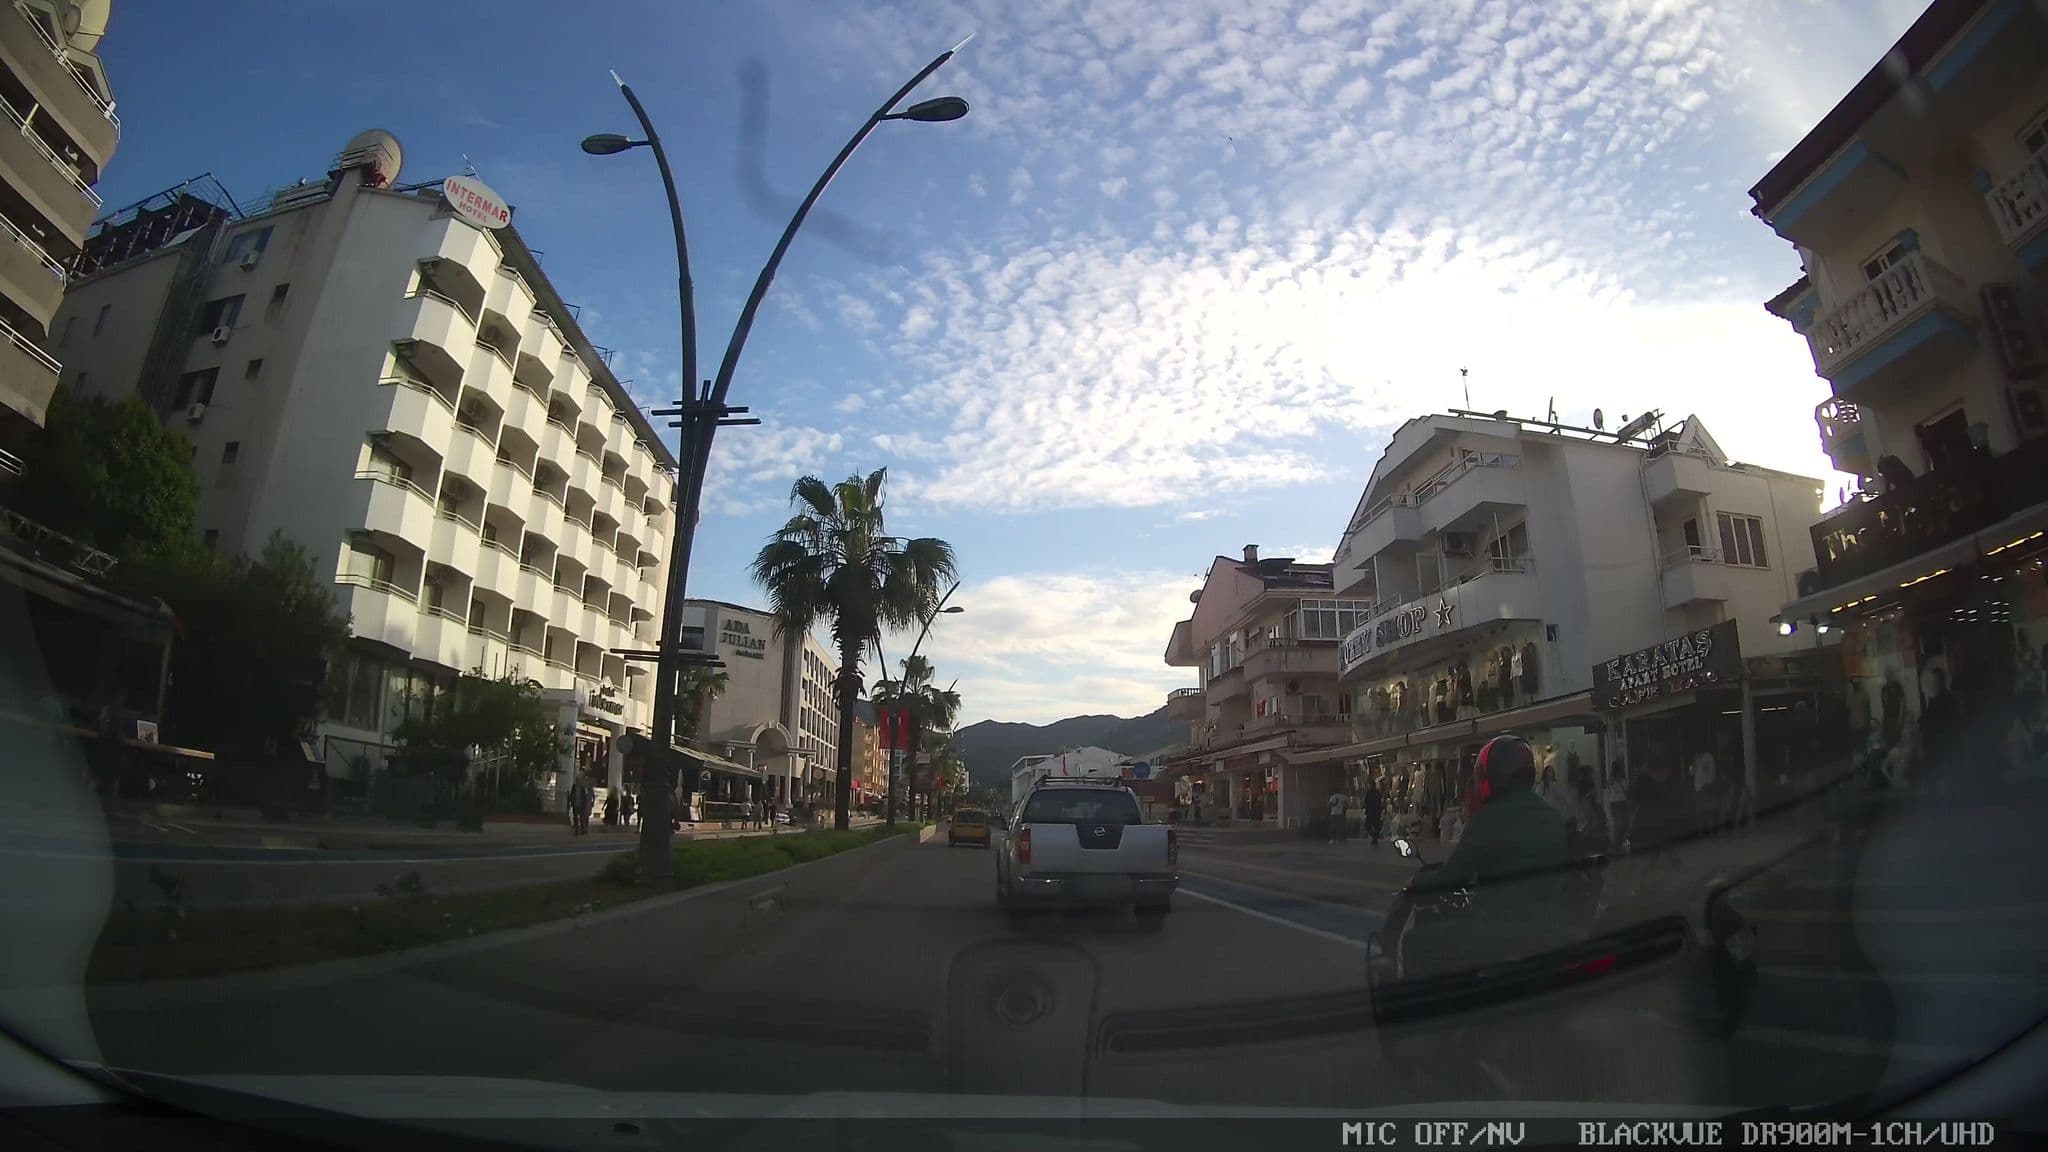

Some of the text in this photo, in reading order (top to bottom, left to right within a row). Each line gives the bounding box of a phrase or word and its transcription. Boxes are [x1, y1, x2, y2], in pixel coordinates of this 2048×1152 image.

[446, 180, 508, 222] INTERMAR
[459, 201, 487, 223] HOTEL
[724, 619, 751, 634] ADA
[1376, 606, 1426, 648] SHOP
[720, 632, 766, 650] JULIAN
[1620, 656, 1704, 691] APART HOTEL
